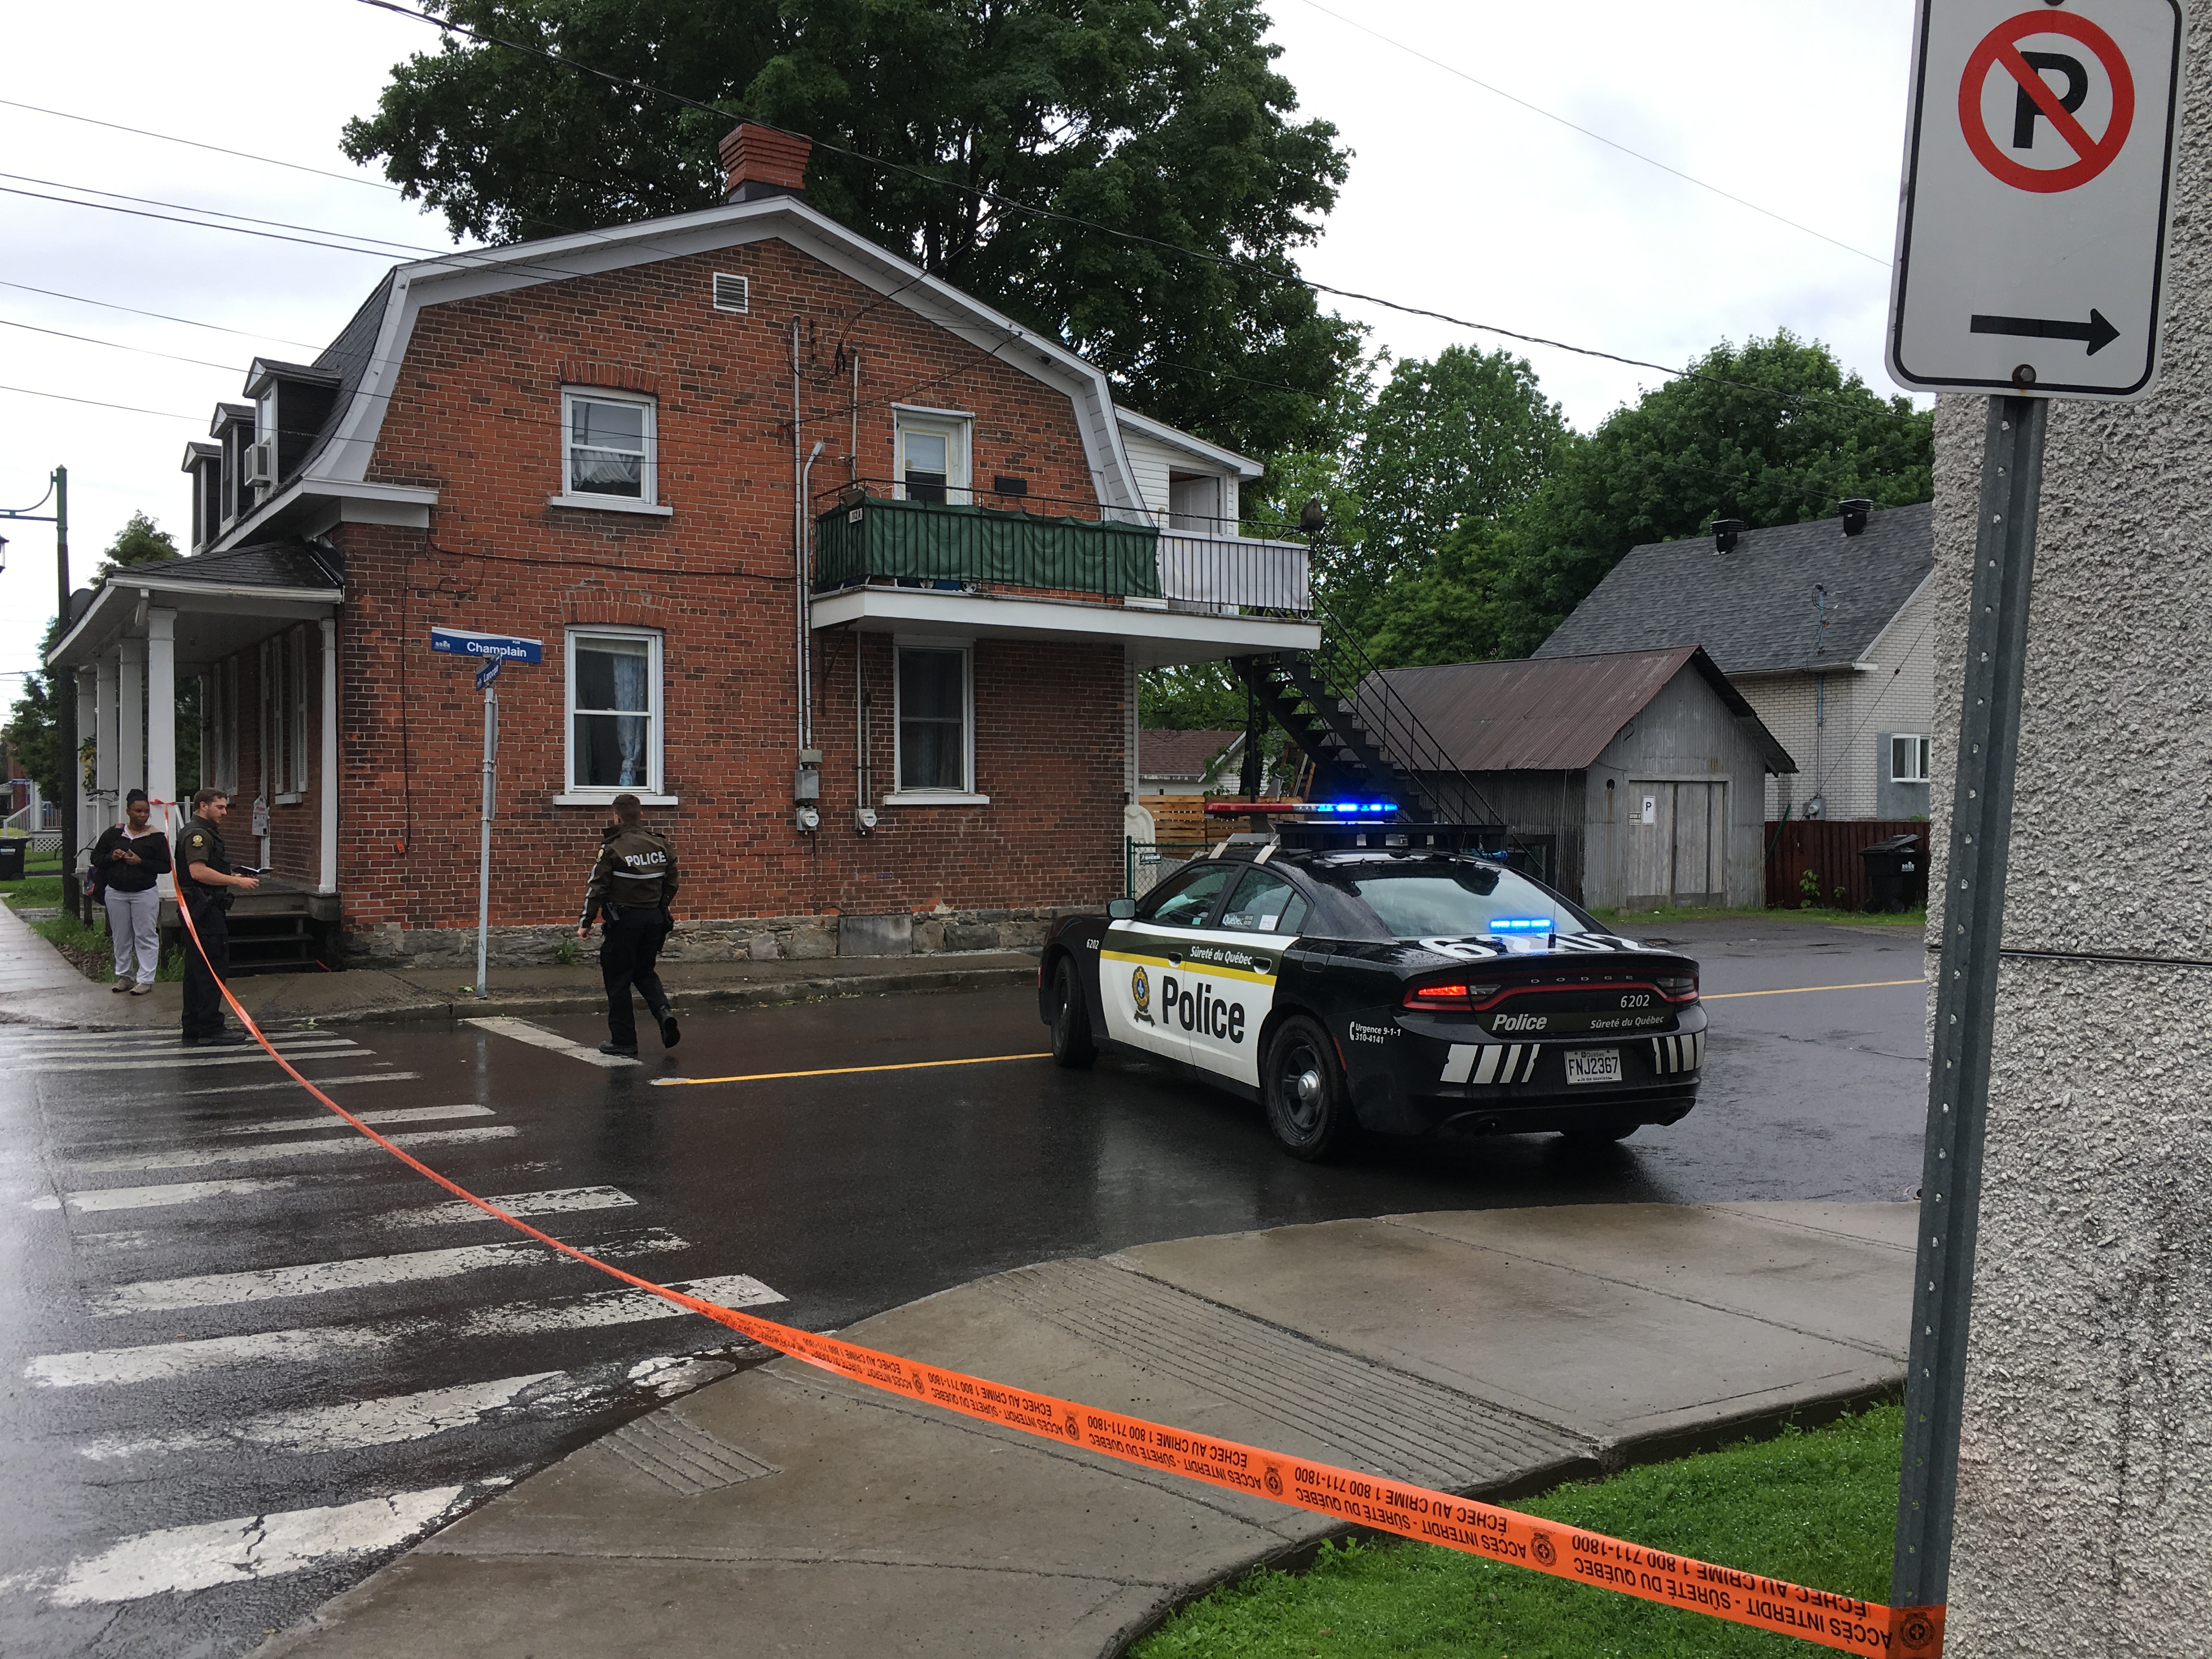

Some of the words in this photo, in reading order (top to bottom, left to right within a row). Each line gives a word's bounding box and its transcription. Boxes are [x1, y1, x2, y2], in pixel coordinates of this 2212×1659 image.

[466, 641, 527, 658] Champlain
[1646, 802, 1652, 811] P
[625, 851, 667, 867] POLICE
[1222, 915, 1244, 926] Québec
[1086, 939, 1099, 950] 6202
[1190, 946, 1214, 960] Sûreté
[1214, 950, 1224, 961] du
[1224, 951, 1253, 966] Québec
[1531, 975, 1633, 984] DODGE
[1162, 975, 1245, 1043] Police
[1621, 994, 1650, 1008] 6202
[1355, 1023, 1382, 1034] Urgence
[1383, 1027, 1401, 1036] 9-1-1
[1492, 1013, 1547, 1031] Police
[1590, 1018, 1620, 1029] Sûreté
[1622, 1018, 1633, 1026] du
[1635, 1015, 1664, 1026] Québec
[1355, 1032, 1384, 1044] 310-4141
[1568, 1057, 1618, 1076] FNJ2367
[959, 1396, 969, 1408] DU
[980, 1387, 1007, 1404] CRIME
[1008, 1395, 1019, 1408] AU
[1022, 1398, 1052, 1418] ÉCHEC
[1003, 1410, 1036, 1426] INTERDIT
[1087, 1415, 1127, 1436] 711-1800
[1088, 1433, 1124, 1452] QUÉBEC
[1129, 1426, 1146, 1441] 800
[1149, 1431, 1153, 1443] 1
[1156, 1432, 1188, 1453] CRIME
[1125, 1443, 1139, 1457] DU
[1139, 1447, 1176, 1467] SÛRETÉ
[1192, 1441, 1207, 1457] AU
[1209, 1446, 1247, 1470] ÉCHEC
[1184, 1459, 1226, 1480] INTERDIT
[1227, 1470, 1261, 1489] ACCÈS
[1295, 1467, 1346, 1492] 711-1800
[1295, 1487, 1341, 1511] QUÉBEC
[1349, 1481, 1371, 1498] 800
[1376, 1487, 1380, 1501] 1
[1344, 1500, 1361, 1516] DU
[1385, 1489, 1428, 1513] CRIME
[1432, 1501, 1452, 1519] AU
[1362, 1505, 1410, 1530] SÛRETÉ
[1456, 1507, 1507, 1536] ÉCHEC
[1421, 1520, 1479, 1546] INTERDIT
[1481, 1534, 1526, 1558] ACCÈS
[1572, 1534, 1643, 1565] 711-1800
[1646, 1551, 1676, 1572] 800
[1683, 1559, 1690, 1576] 1
[1573, 1558, 1636, 1585] QUÉBEC
[1696, 1564, 1756, 1590] CRIME
[1640, 1573, 1662, 1593] DU
[1761, 1579, 1787, 1598] AU
[1666, 1579, 1731, 1610] SÛRETÉ
[1746, 1599, 1825, 1632] INTERDIT
[1829, 1618, 1893, 1650] ACCÈS
